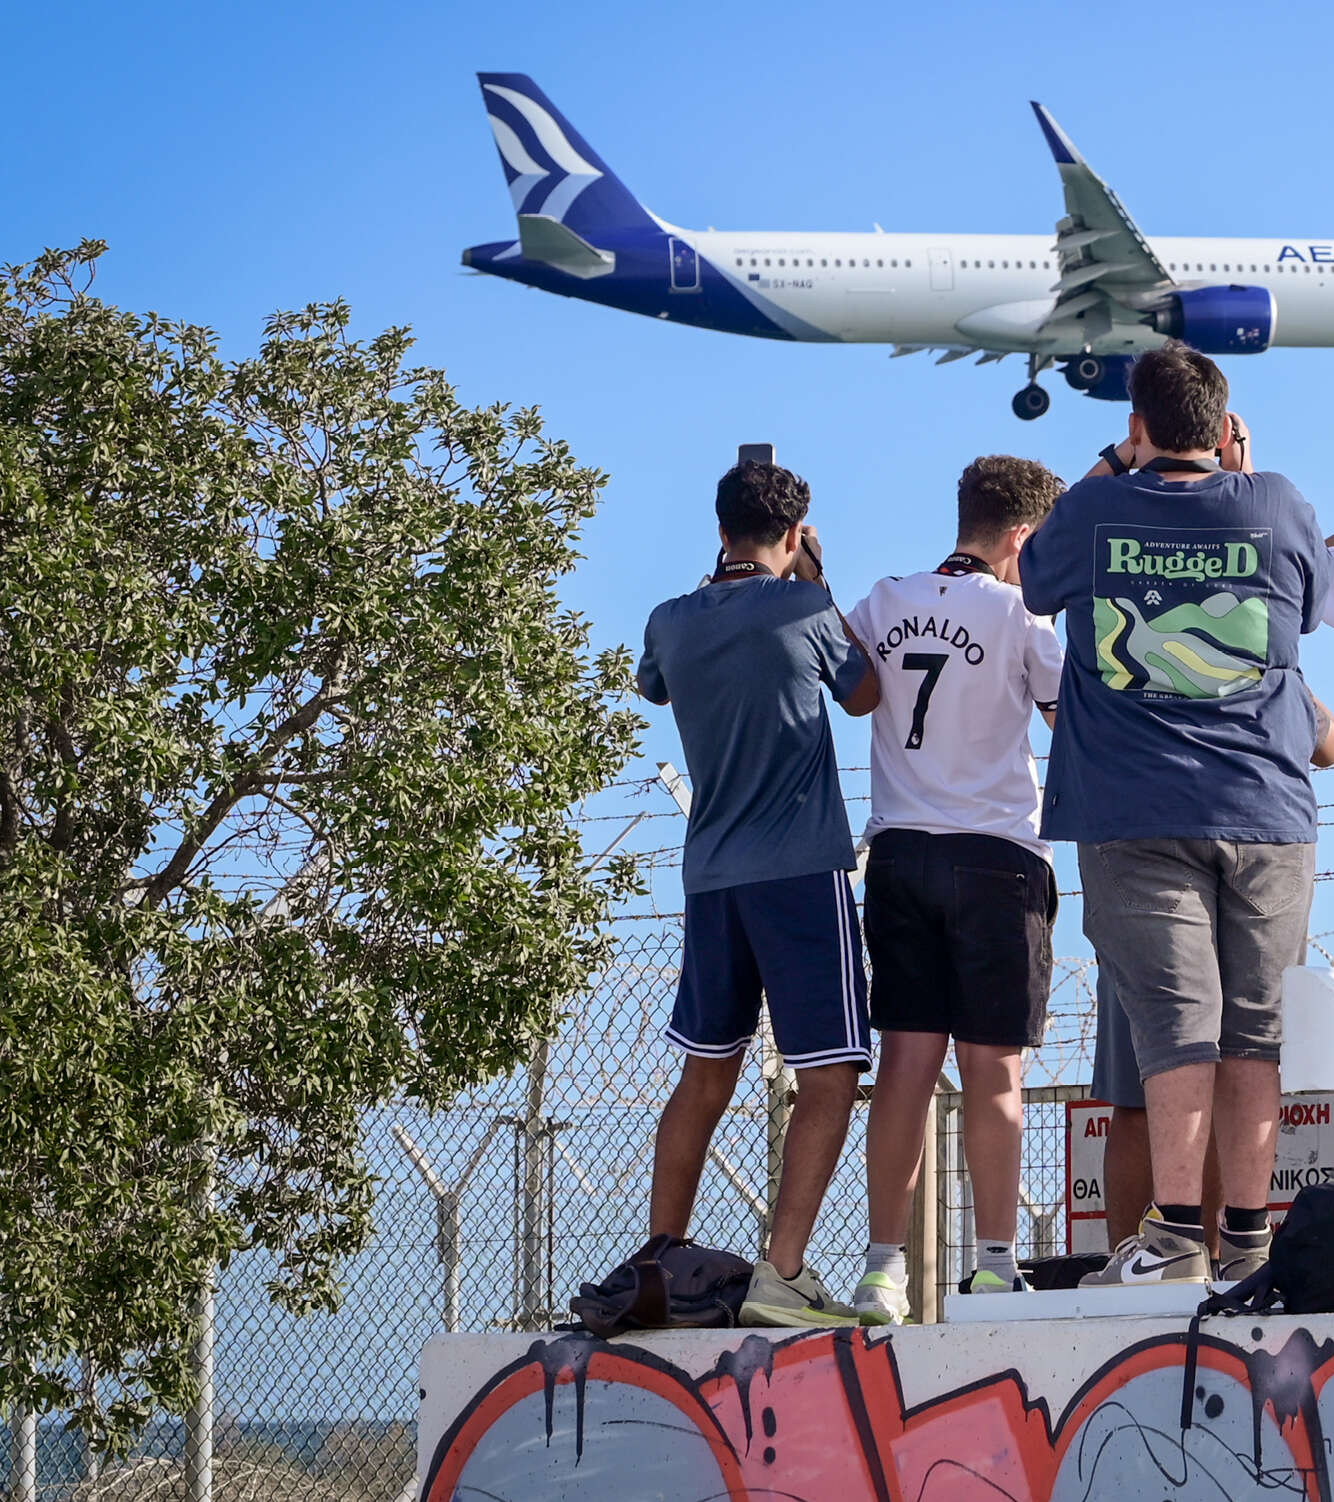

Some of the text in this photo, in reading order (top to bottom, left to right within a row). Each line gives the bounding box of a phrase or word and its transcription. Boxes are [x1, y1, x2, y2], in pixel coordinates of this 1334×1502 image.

[1144, 541, 1191, 549] ADVENTURE
[726, 562, 754, 571] Canon
[876, 616, 984, 666] RONALDO
[902, 653, 949, 749] 7
